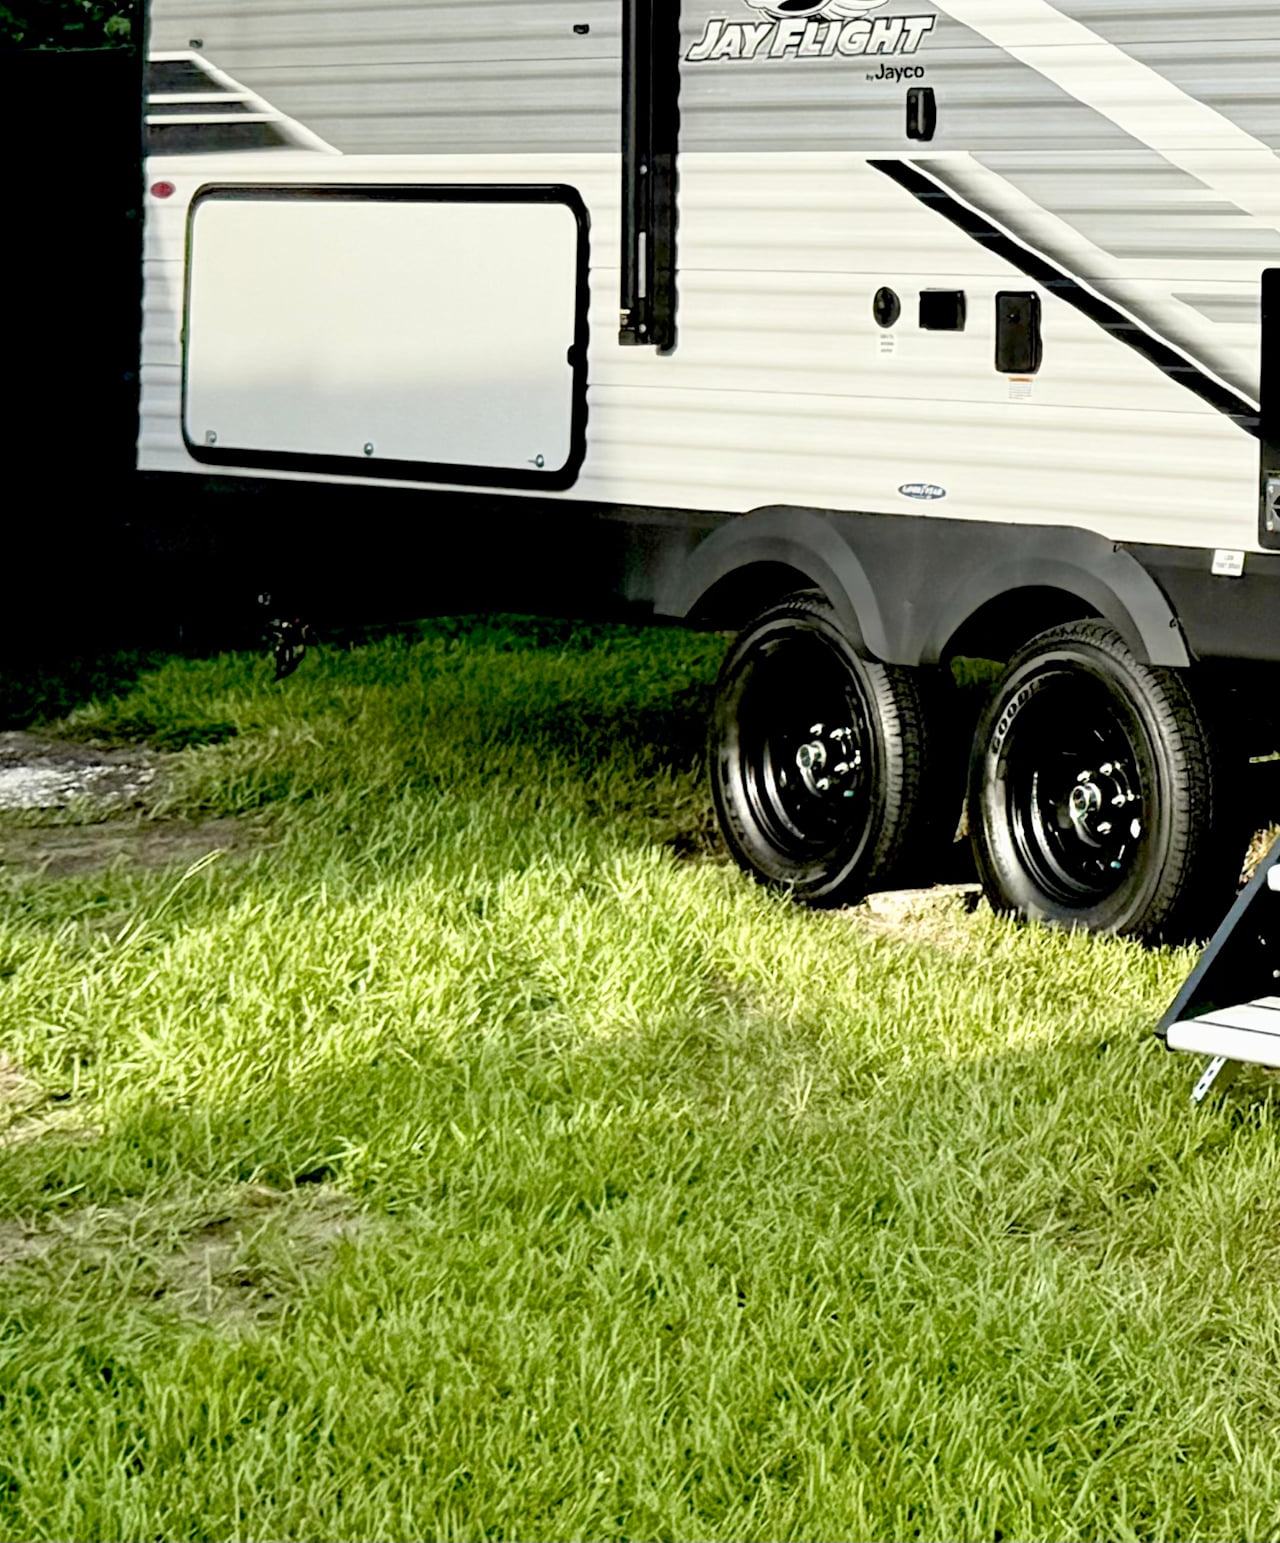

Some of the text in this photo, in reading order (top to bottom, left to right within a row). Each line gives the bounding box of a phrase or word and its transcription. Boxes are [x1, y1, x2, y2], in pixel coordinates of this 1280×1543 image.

[684, 14, 937, 61] JAY FLIGHT
[875, 63, 925, 83] Jayco
